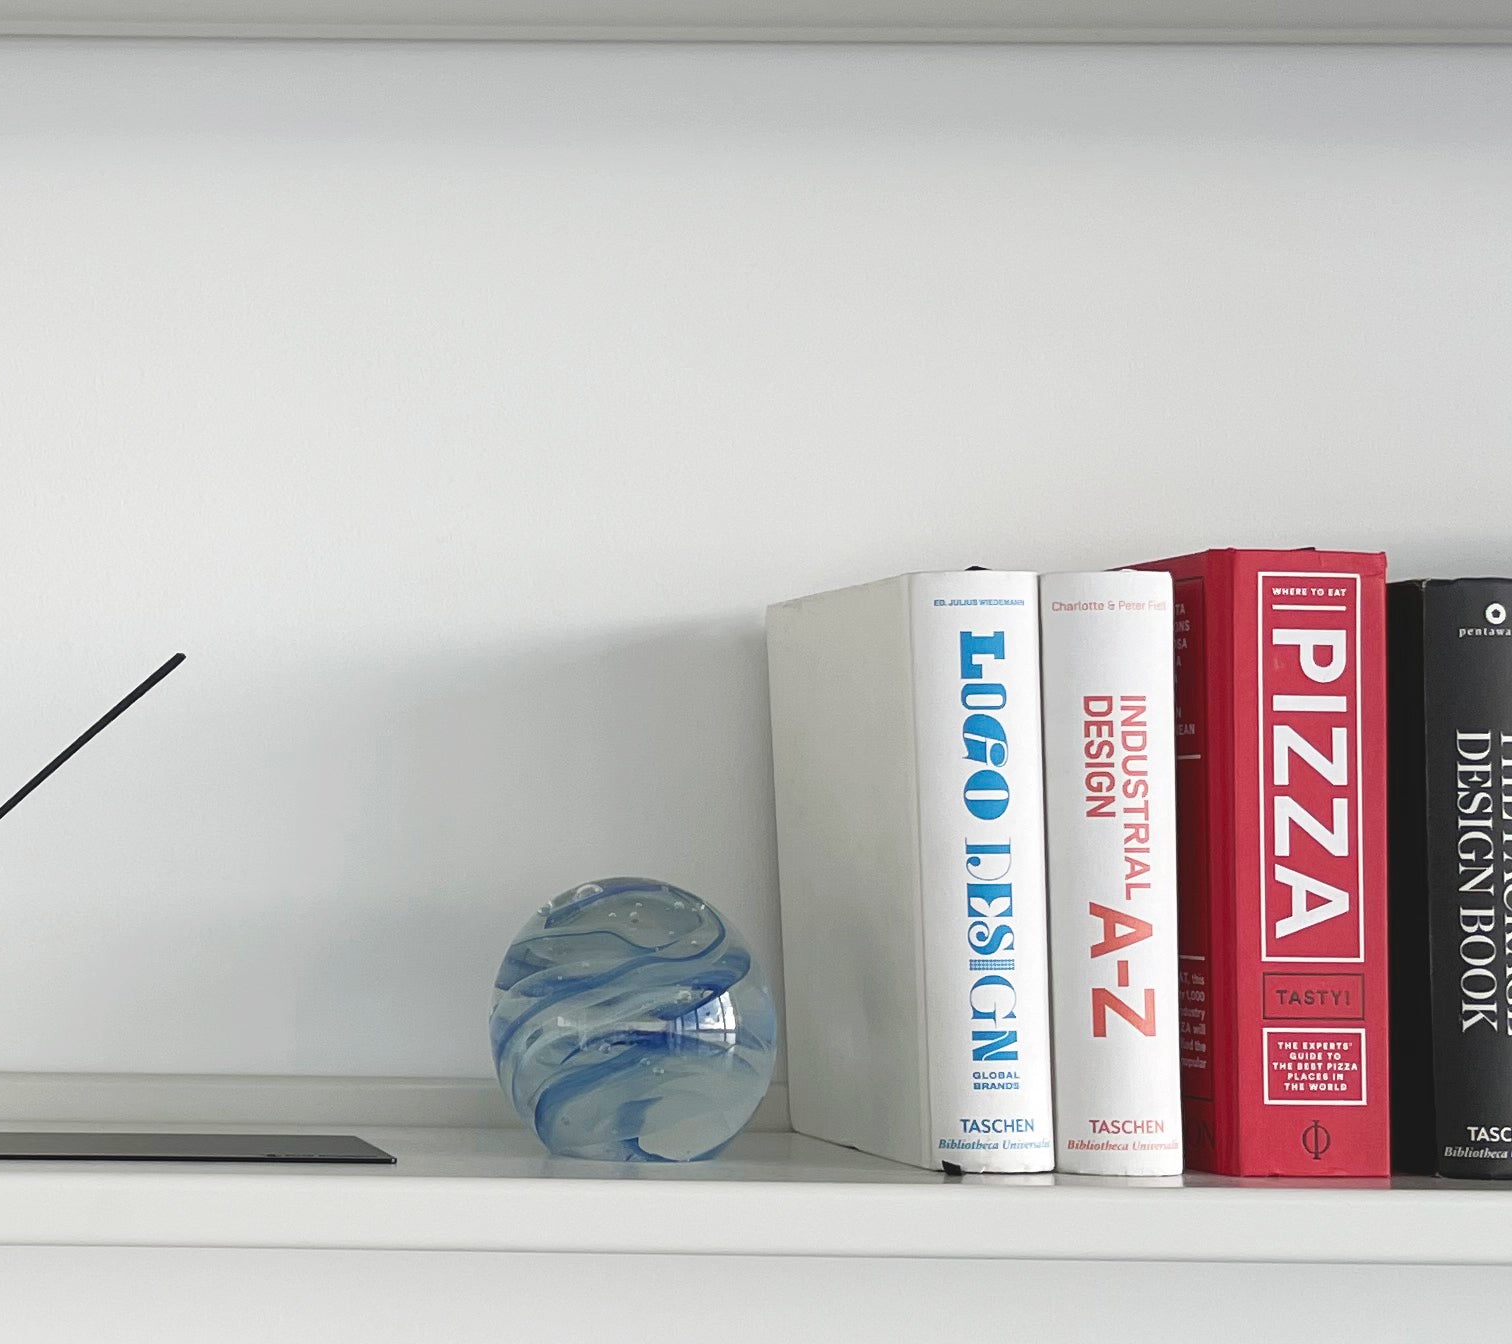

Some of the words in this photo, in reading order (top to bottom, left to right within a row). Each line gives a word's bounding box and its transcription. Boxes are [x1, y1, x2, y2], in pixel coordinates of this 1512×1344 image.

[1271, 587, 1308, 597] WHERE
[1310, 587, 1326, 597] TO
[1327, 587, 1347, 597] EAT
[959, 630, 1010, 821] LOGO
[1082, 694, 1117, 818] DESIGN
[1271, 628, 1350, 940] PIZZA
[1119, 694, 1152, 901] INDUSTRIAL
[1456, 728, 1495, 897] DESIGN
[964, 836, 1019, 1062] DESIGN
[1088, 901, 1157, 1038] A-Z
[1458, 906, 1499, 1034] BOOK
[1289, 1052, 1324, 1061] GUIDE
[1326, 1052, 1342, 1061] TO
[1272, 1062, 1294, 1071] THE
[1296, 1062, 1324, 1071] BEST
[1326, 1062, 1359, 1071] PIZZA
[972, 1071, 1021, 1080] GLOBAL
[972, 1081, 1021, 1091] BRANDS
[1283, 1082, 1306, 1092] THE
[1308, 1082, 1348, 1092] WORLD
[959, 1118, 1035, 1135] TASCHEN
[1088, 1119, 1165, 1135] TASCHEN
[1443, 1146, 1508, 1159] Bibliotheca
